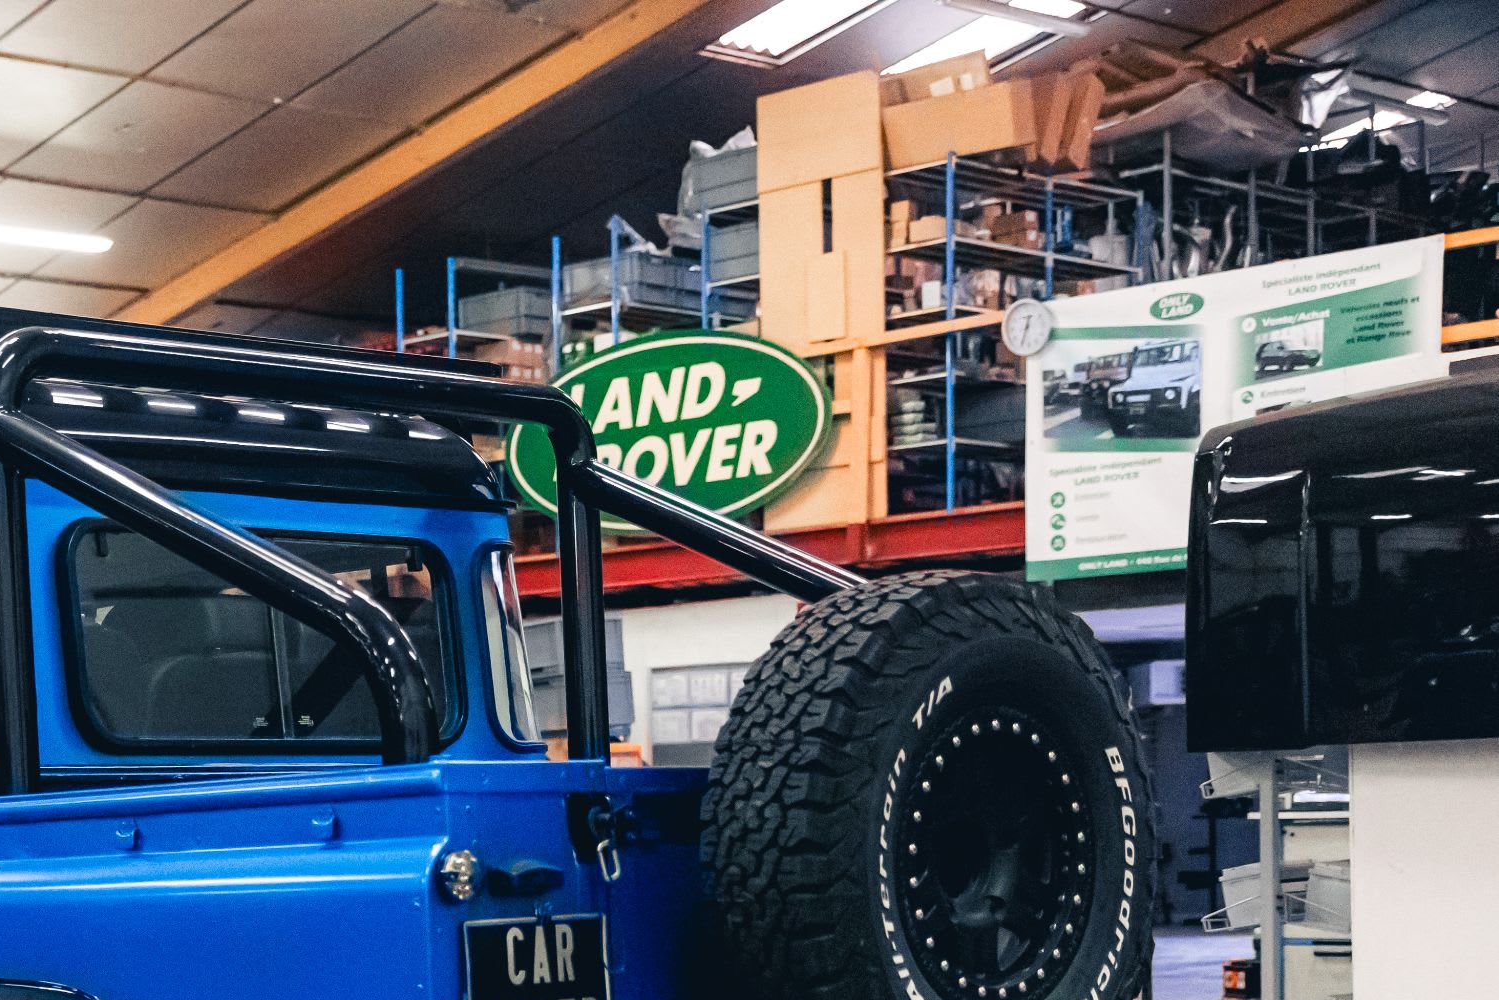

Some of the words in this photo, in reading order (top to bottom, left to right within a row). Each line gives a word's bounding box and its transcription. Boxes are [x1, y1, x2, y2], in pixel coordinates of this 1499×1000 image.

[1288, 284, 1316, 296] LAND
[1320, 278, 1357, 294] ROVER
[912, 676, 953, 730] T/A
[506, 923, 576, 986] CAR
